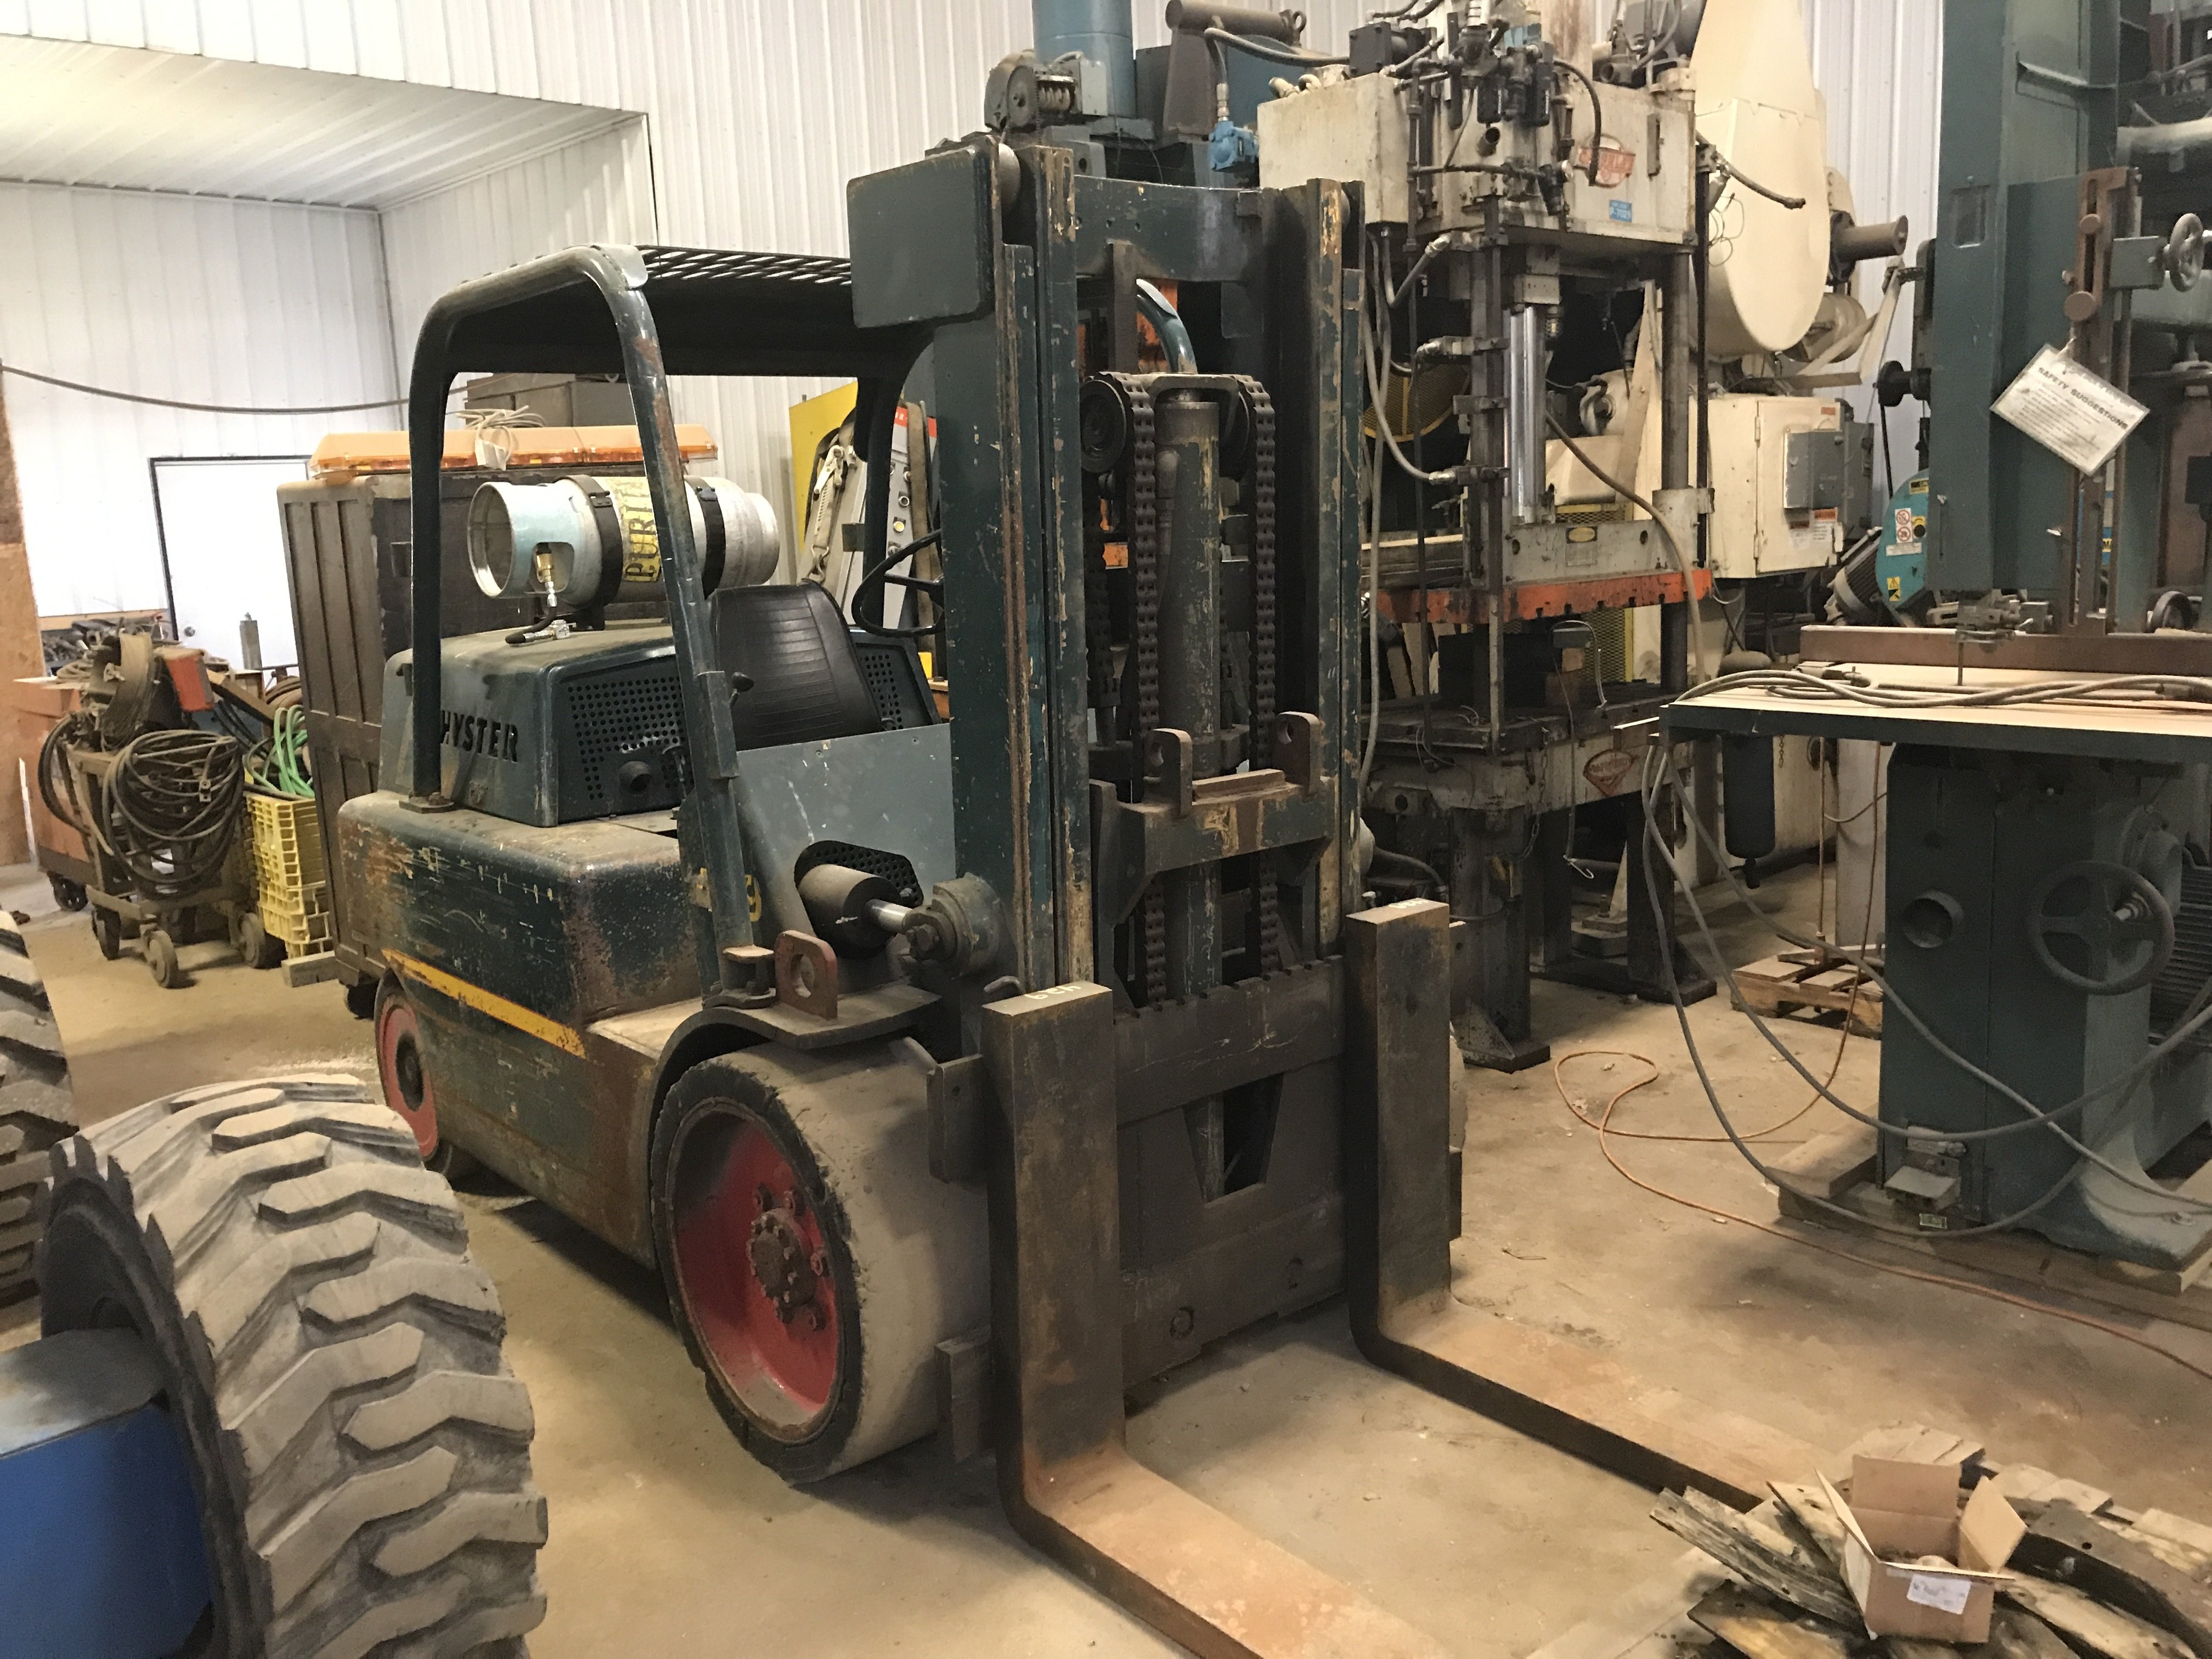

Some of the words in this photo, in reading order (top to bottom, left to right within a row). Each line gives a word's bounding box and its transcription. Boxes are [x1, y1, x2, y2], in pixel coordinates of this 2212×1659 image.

[2038, 367, 2069, 390] SAFETY
[2070, 388, 2129, 430] SUGGESTIONS
[441, 709, 518, 762] HYSTER
